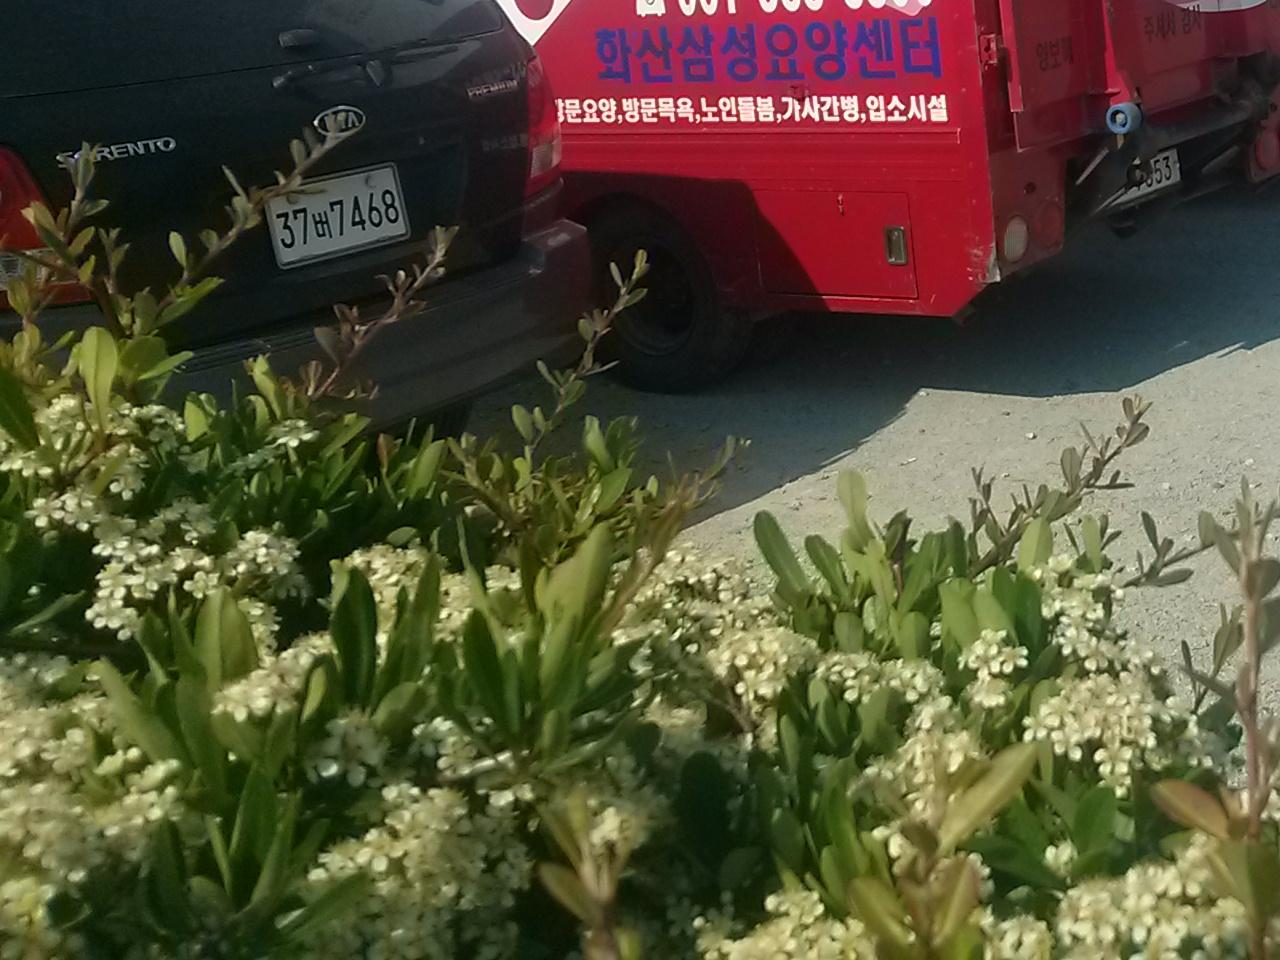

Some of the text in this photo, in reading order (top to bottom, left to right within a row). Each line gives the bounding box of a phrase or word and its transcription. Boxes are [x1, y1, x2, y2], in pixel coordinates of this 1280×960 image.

[595, 16, 942, 84] 화산삼성요양센터
[56, 136, 177, 169] SRENTO
[275, 188, 400, 249] 37버7468
